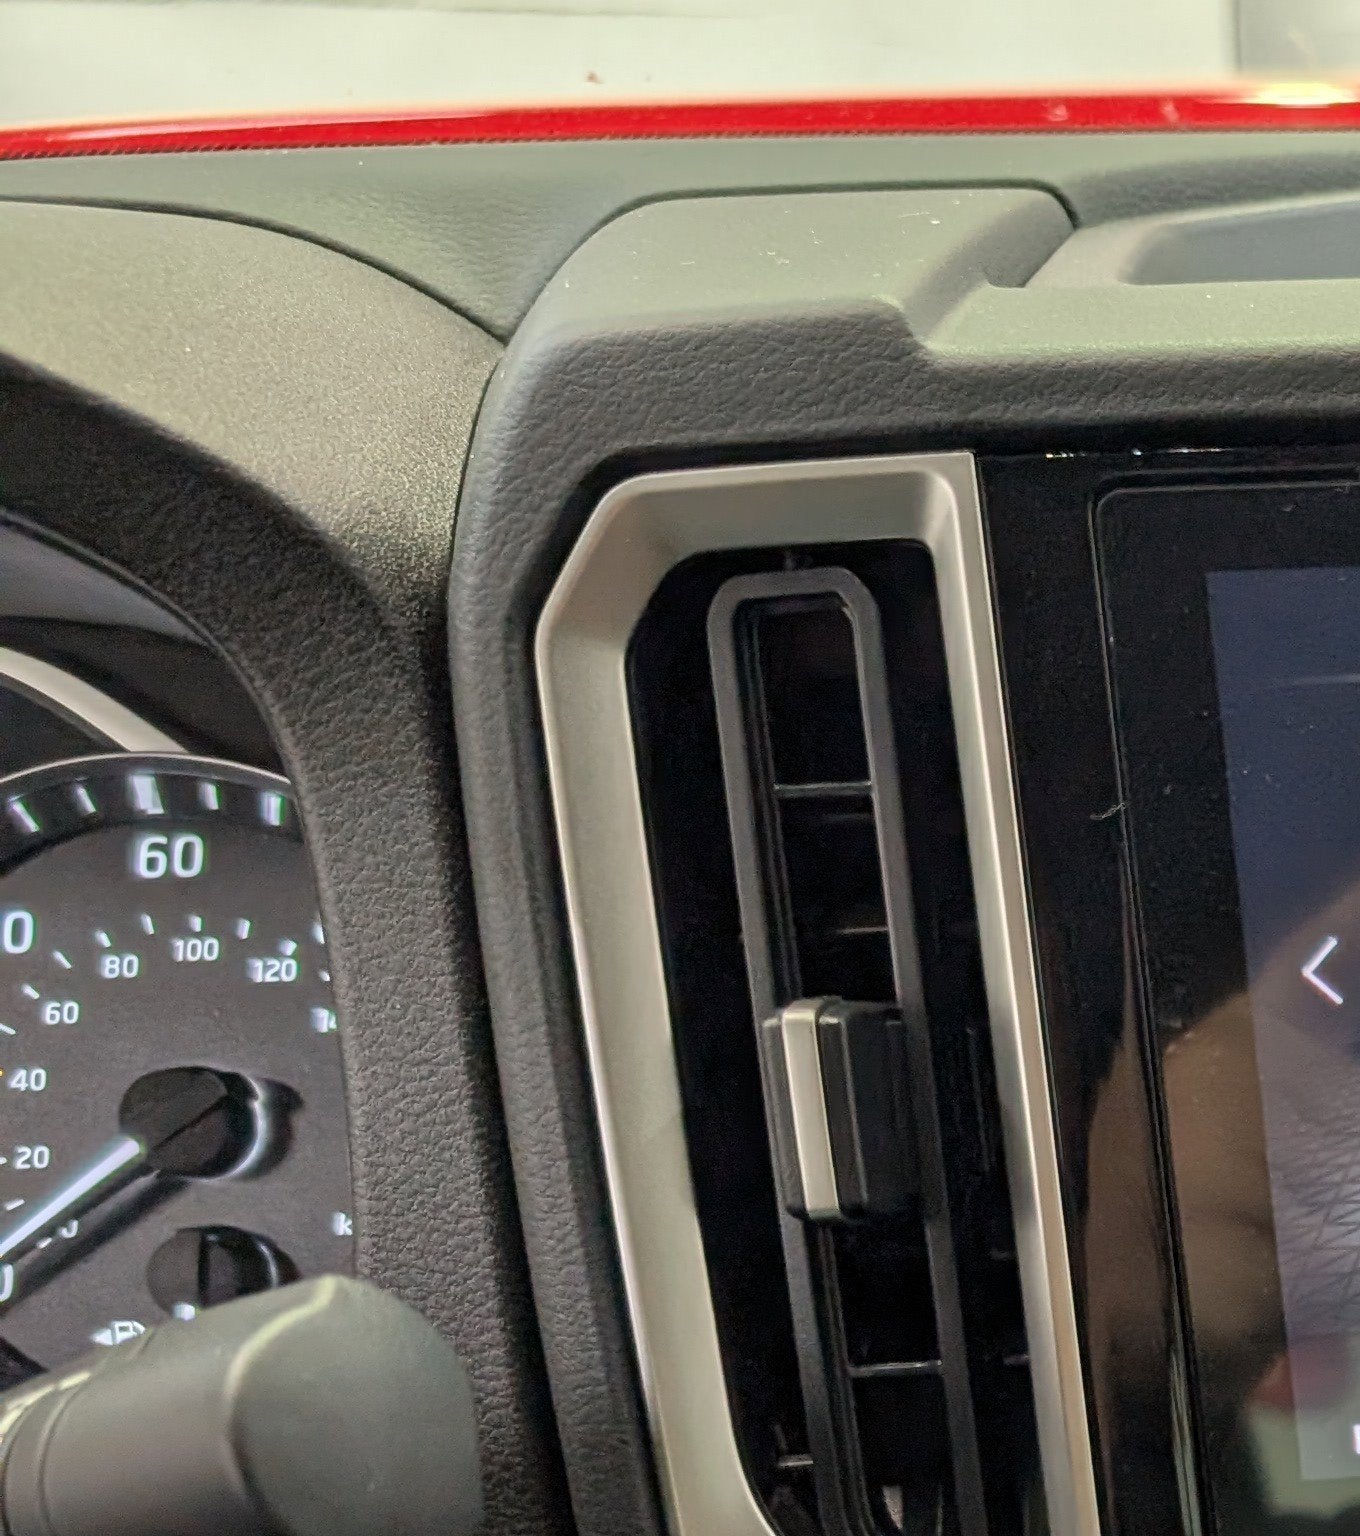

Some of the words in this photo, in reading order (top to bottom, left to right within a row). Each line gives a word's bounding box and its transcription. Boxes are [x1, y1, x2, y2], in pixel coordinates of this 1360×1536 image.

[136, 834, 205, 879] 60
[172, 938, 220, 963] 100
[101, 954, 139, 979] 80
[249, 958, 298, 982] 120
[43, 1002, 80, 1025] 60
[10, 1068, 47, 1092] 40
[14, 1146, 49, 1170] 20
